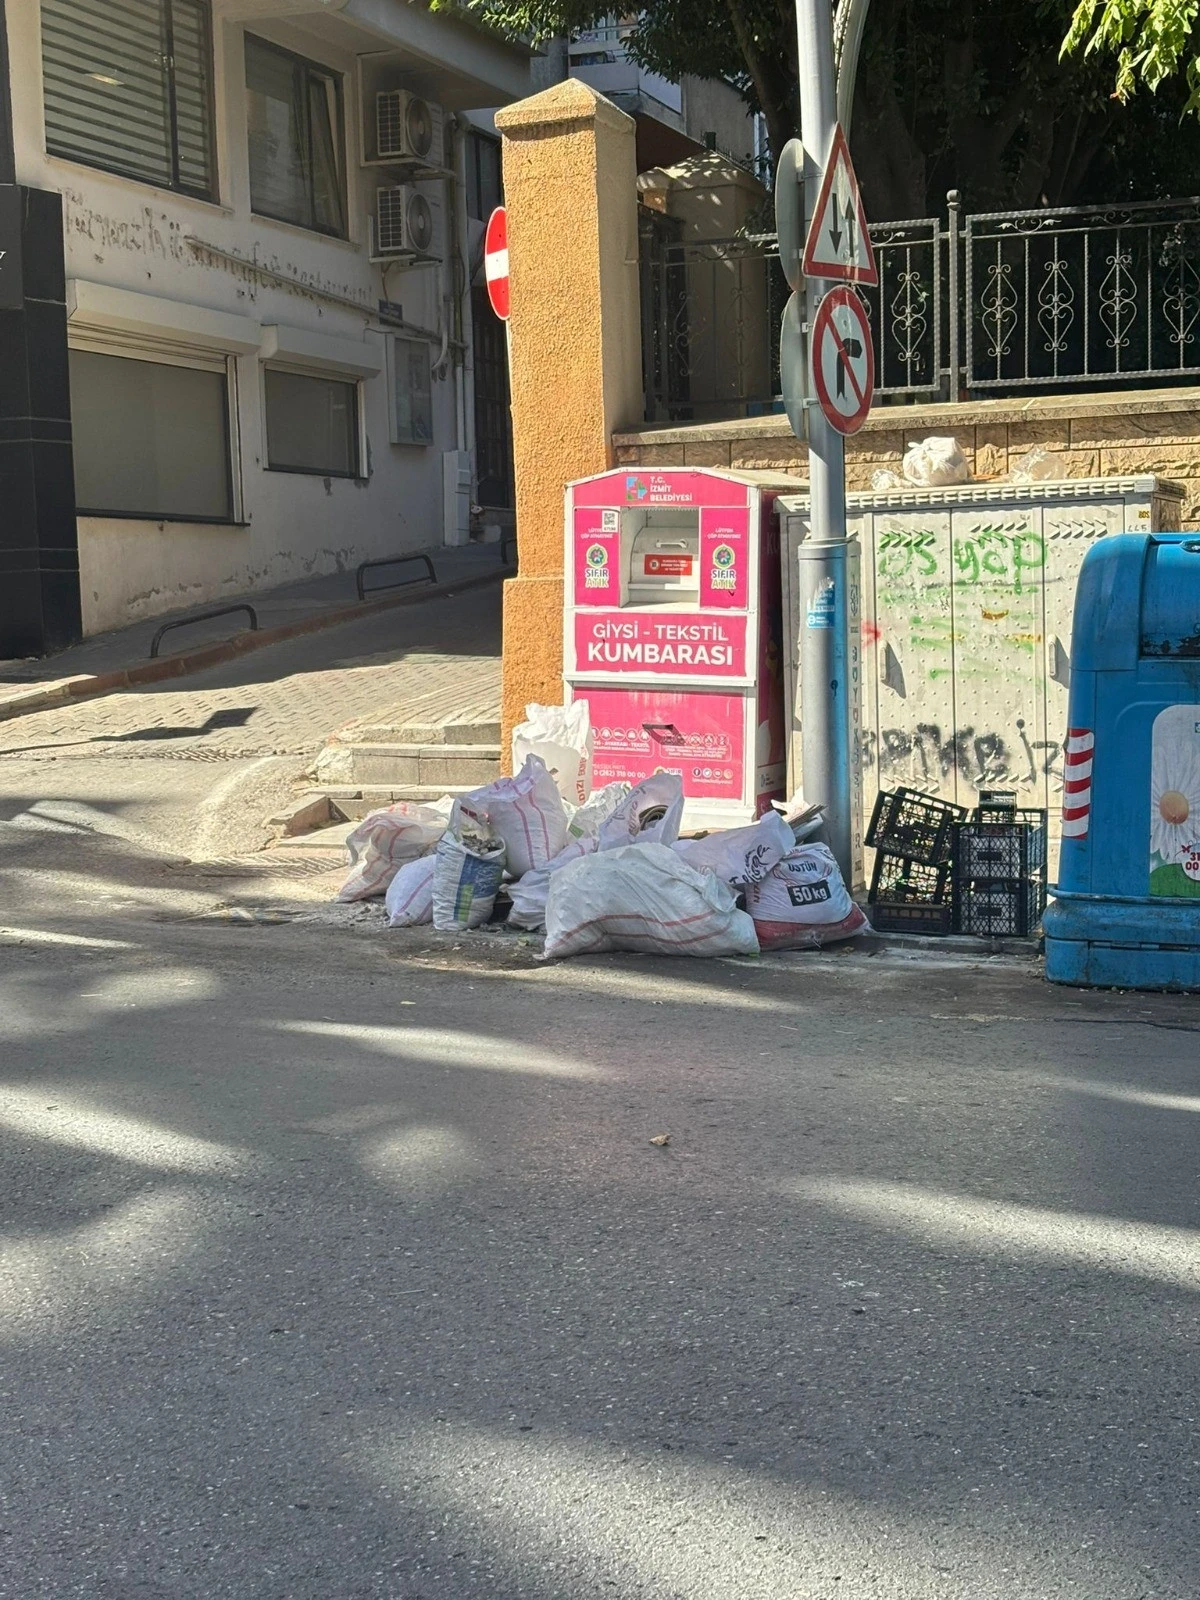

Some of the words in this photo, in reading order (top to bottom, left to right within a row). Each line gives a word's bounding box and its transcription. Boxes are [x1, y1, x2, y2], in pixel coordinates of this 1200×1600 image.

[650, 484, 672, 492] İZMİT
[650, 493, 693, 502] BELEDİYESİ
[586, 569, 608, 577] SIFIR
[712, 570, 735, 579] SIFIR
[586, 578, 608, 587] ATIK
[712, 580, 735, 588] ATIK
[593, 620, 638, 638] GİYSİ
[654, 622, 728, 641] TEKSTİL
[588, 642, 733, 665] KUMBARASI
[1185, 862, 1199, 870] 00
[793, 886, 812, 903] 50
[812, 887, 828, 899] kg
